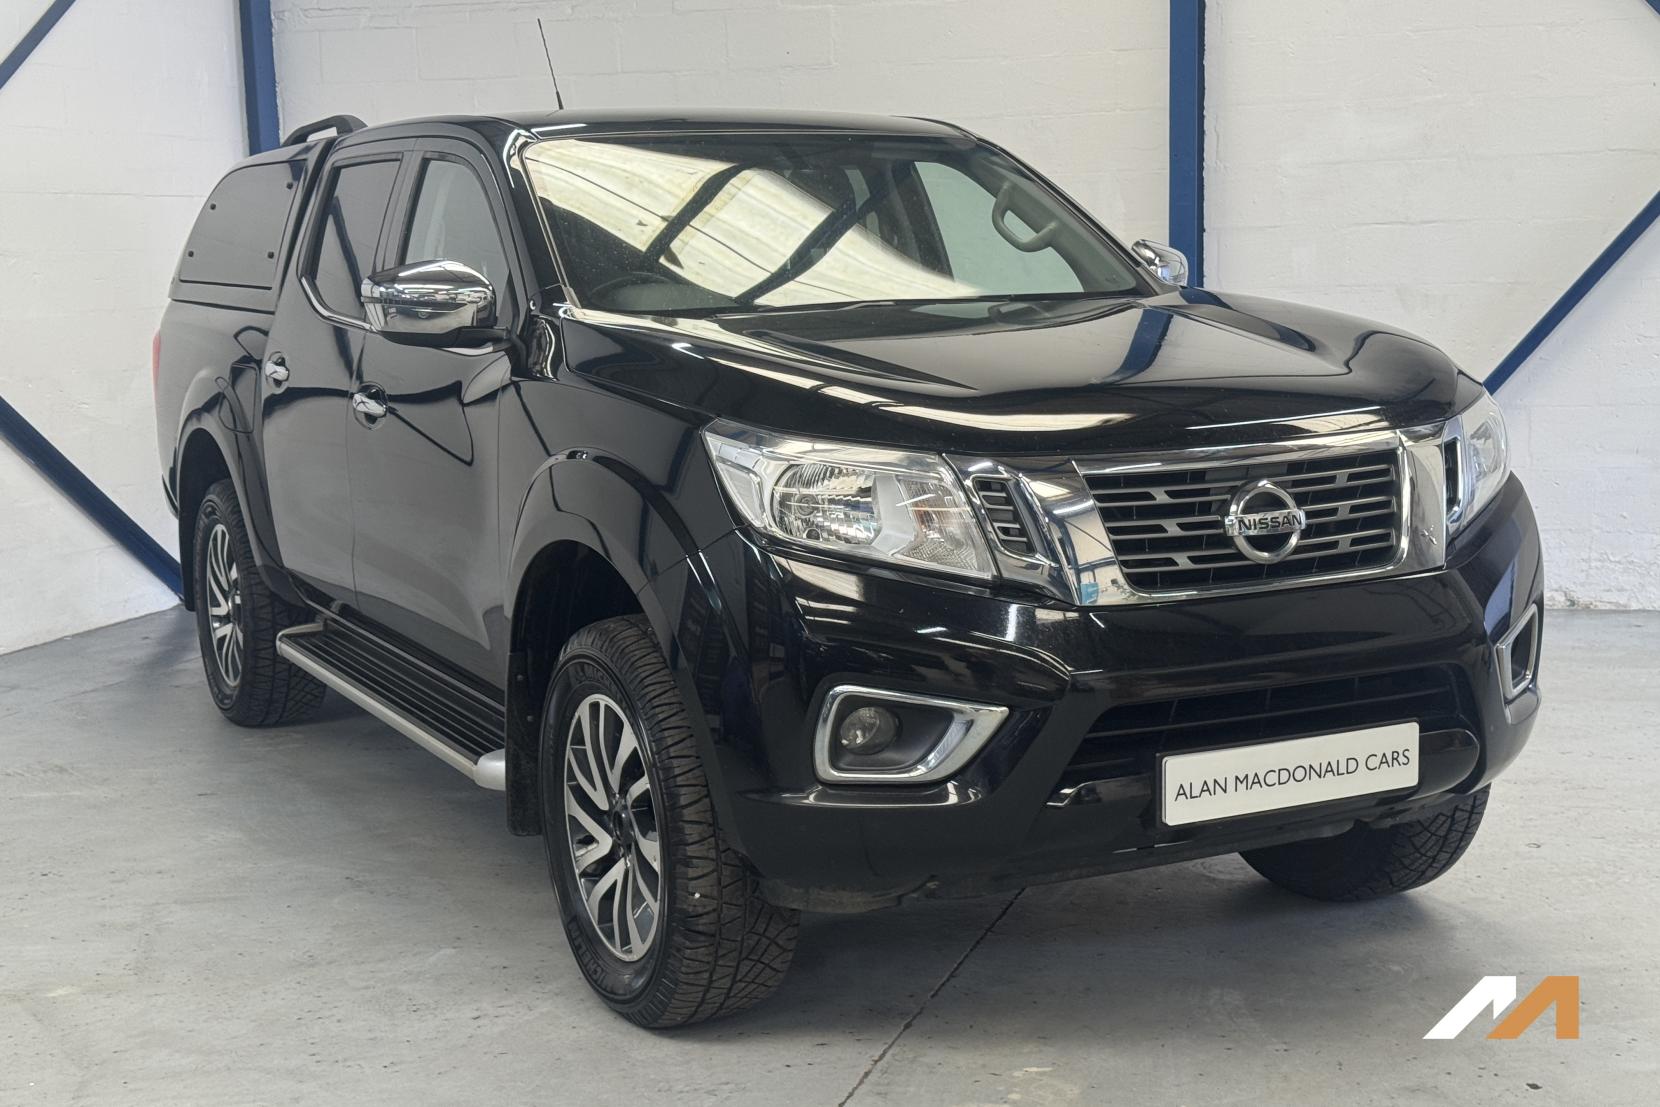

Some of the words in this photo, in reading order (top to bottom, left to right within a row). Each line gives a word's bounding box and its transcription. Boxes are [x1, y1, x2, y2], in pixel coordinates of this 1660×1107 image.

[1238, 514, 1302, 531] NISSAN
[1174, 777, 1228, 801] ALAN
[1234, 758, 1359, 792] MACDONALD
[1365, 748, 1411, 771] CARS
